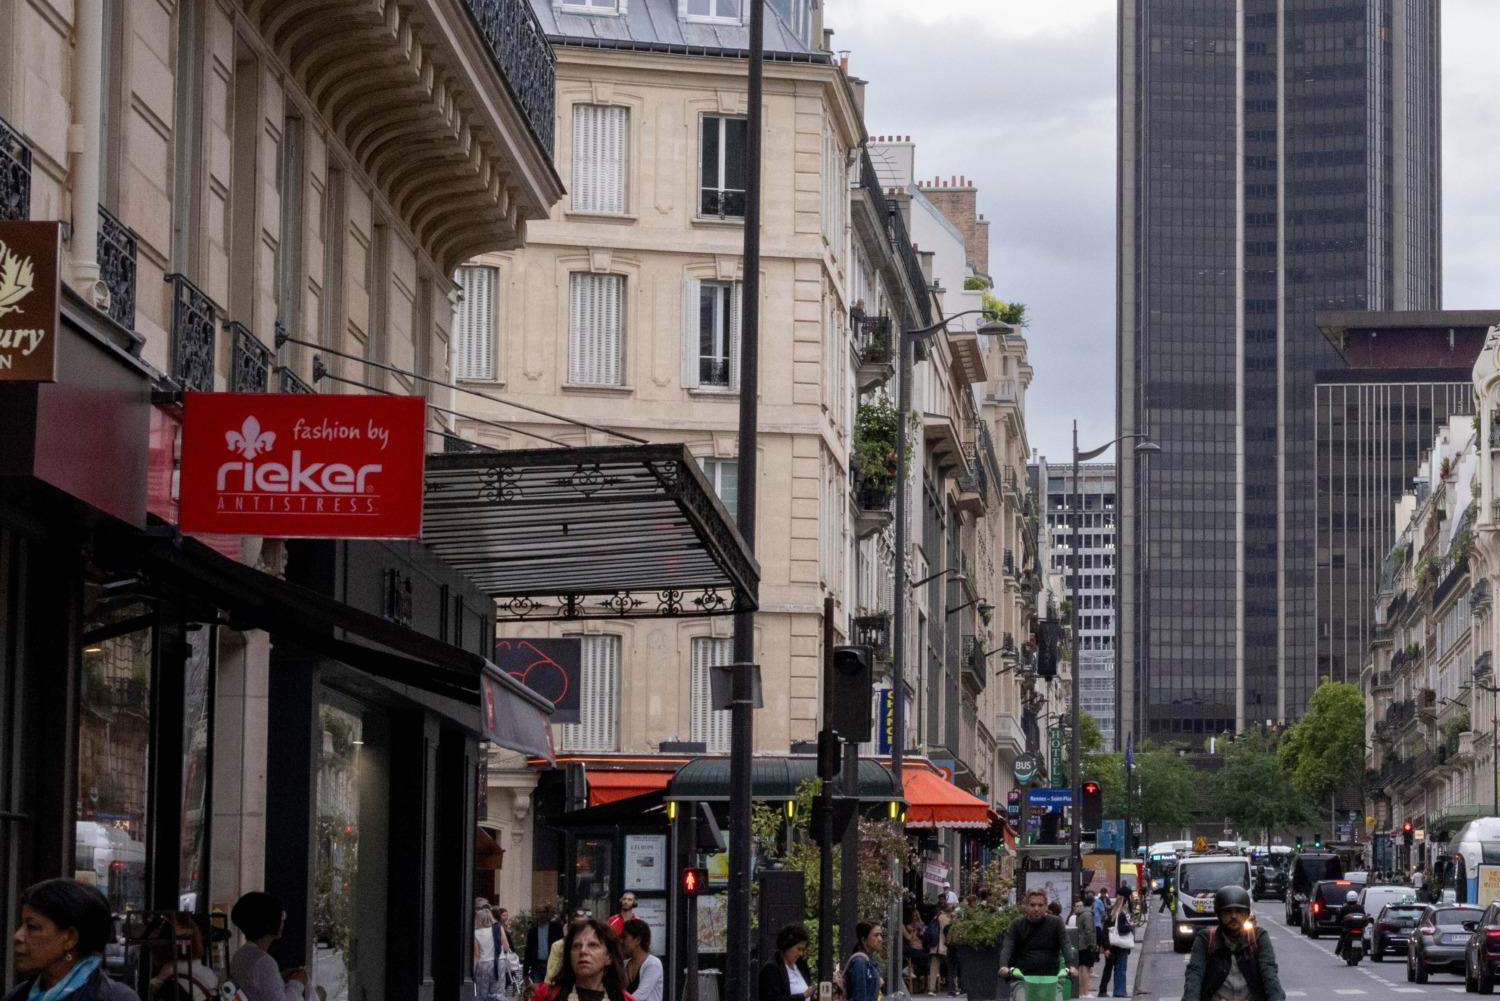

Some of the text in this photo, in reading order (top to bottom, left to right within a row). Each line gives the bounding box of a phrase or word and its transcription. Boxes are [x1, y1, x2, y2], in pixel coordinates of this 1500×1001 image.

[293, 418, 389, 450] fashion by
[216, 450, 382, 493] rieker
[217, 497, 374, 512] ANTISTRESS
[1015, 761, 1032, 770] BUS
[1051, 730, 1061, 776] HOTEL
